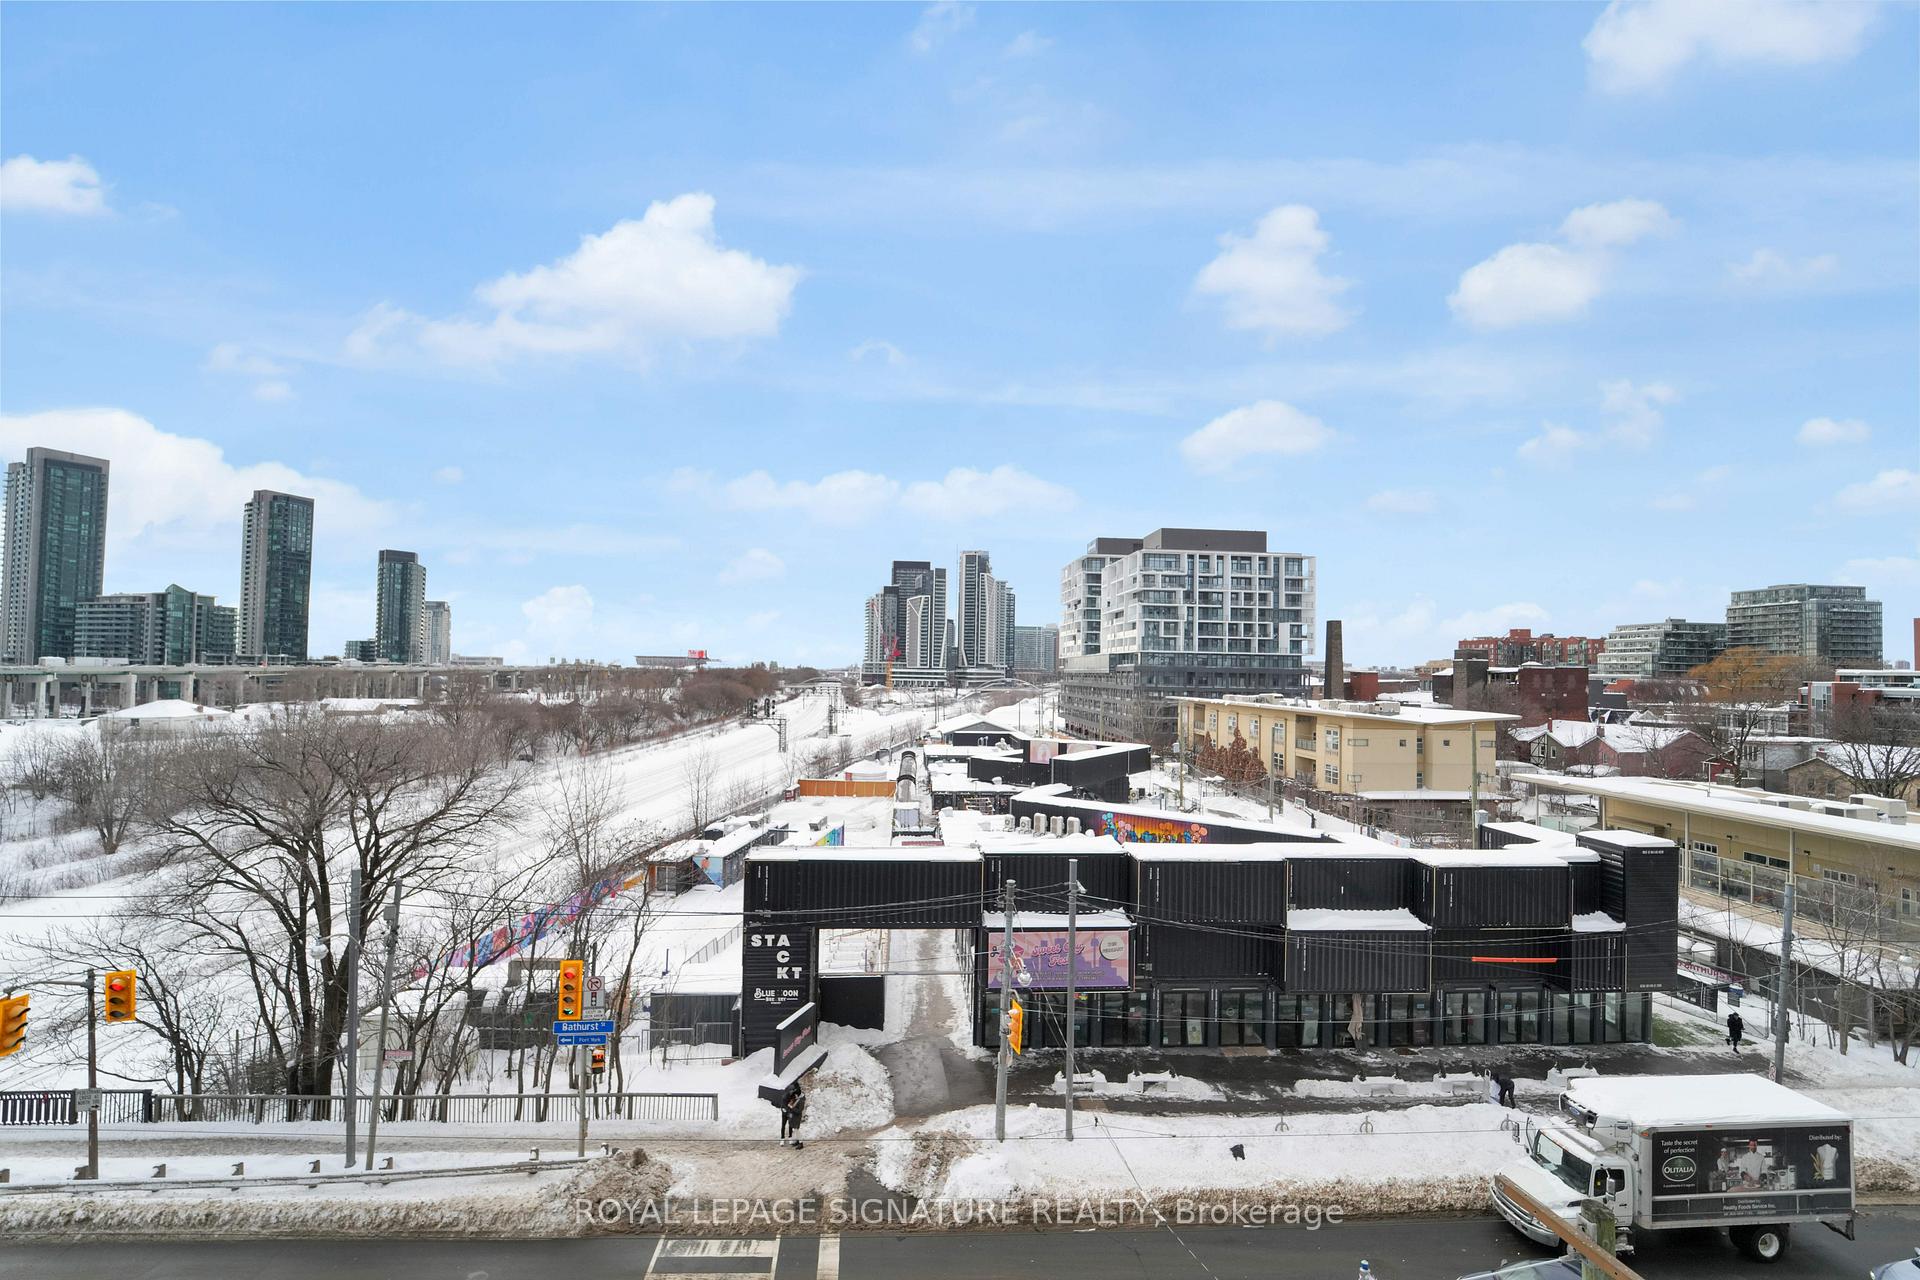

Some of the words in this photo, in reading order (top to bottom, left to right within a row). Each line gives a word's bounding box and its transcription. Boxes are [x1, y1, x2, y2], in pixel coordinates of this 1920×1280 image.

[1048, 953, 1071, 968] Fes
[754, 987, 775, 998] BLUE
[777, 989, 799, 997] OON
[562, 1022, 598, 1031] Bathurst
[1670, 1146, 1696, 1155] perfection
[1664, 1166, 1694, 1174] OLITALIA
